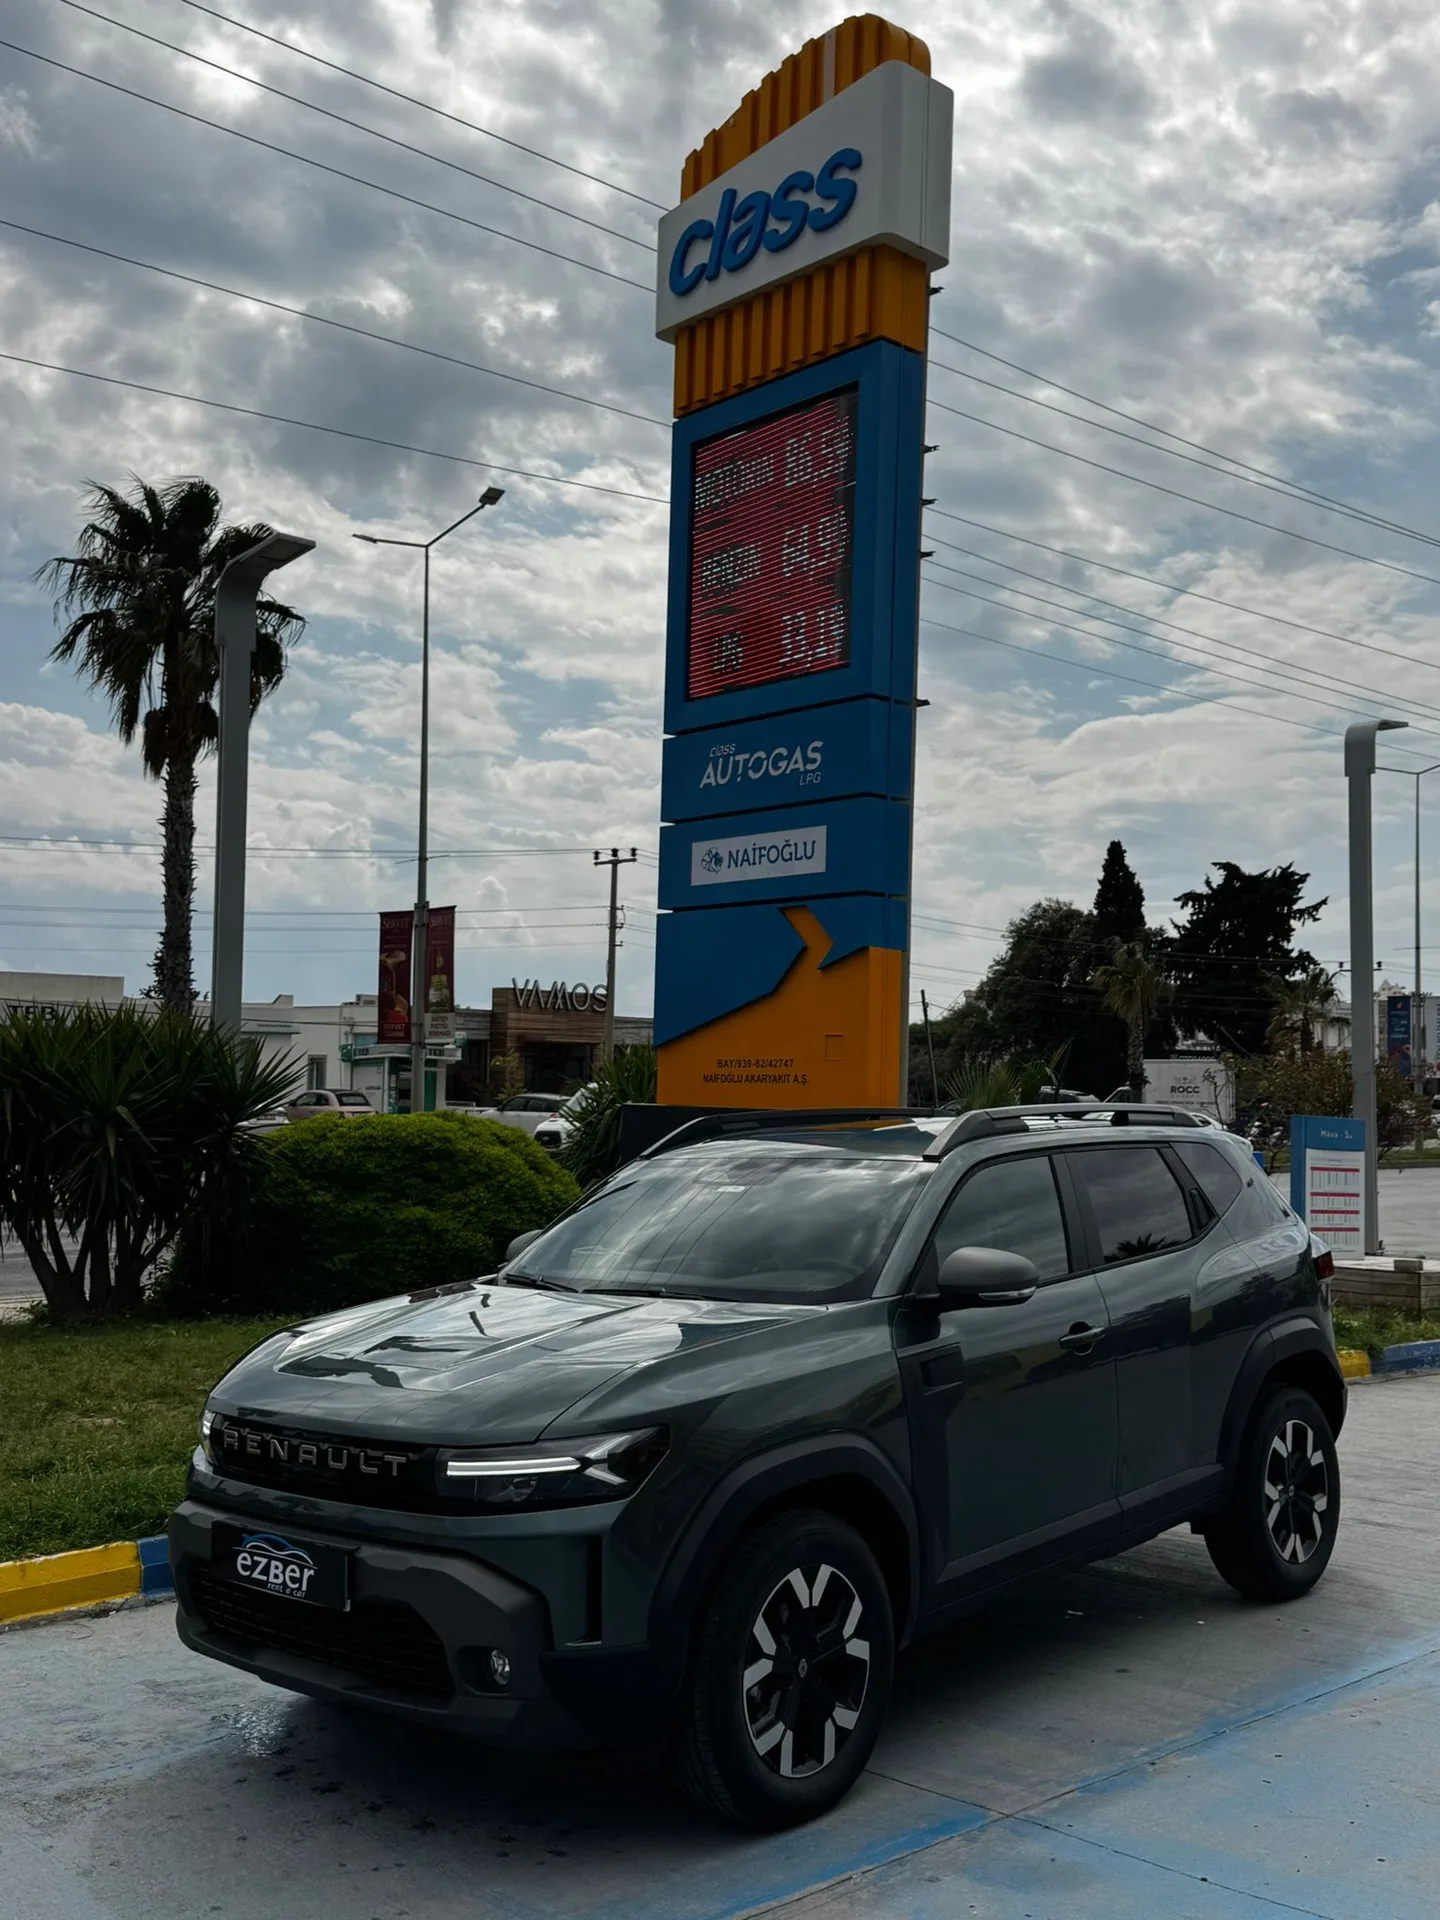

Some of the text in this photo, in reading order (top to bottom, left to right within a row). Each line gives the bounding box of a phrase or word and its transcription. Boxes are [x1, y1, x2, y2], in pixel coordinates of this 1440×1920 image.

[668, 147, 863, 297] class
[699, 740, 825, 789] AUTOGAS
[709, 743, 736, 758] class
[799, 771, 822, 786] LPG
[727, 839, 817, 869] NAİFOĞLU
[511, 977, 608, 1012] VAMOS
[1170, 1085, 1200, 1094] ROCC
[223, 1428, 408, 1477] RENAULT
[267, 1582, 284, 1593] rent
[293, 1589, 307, 1598] car
